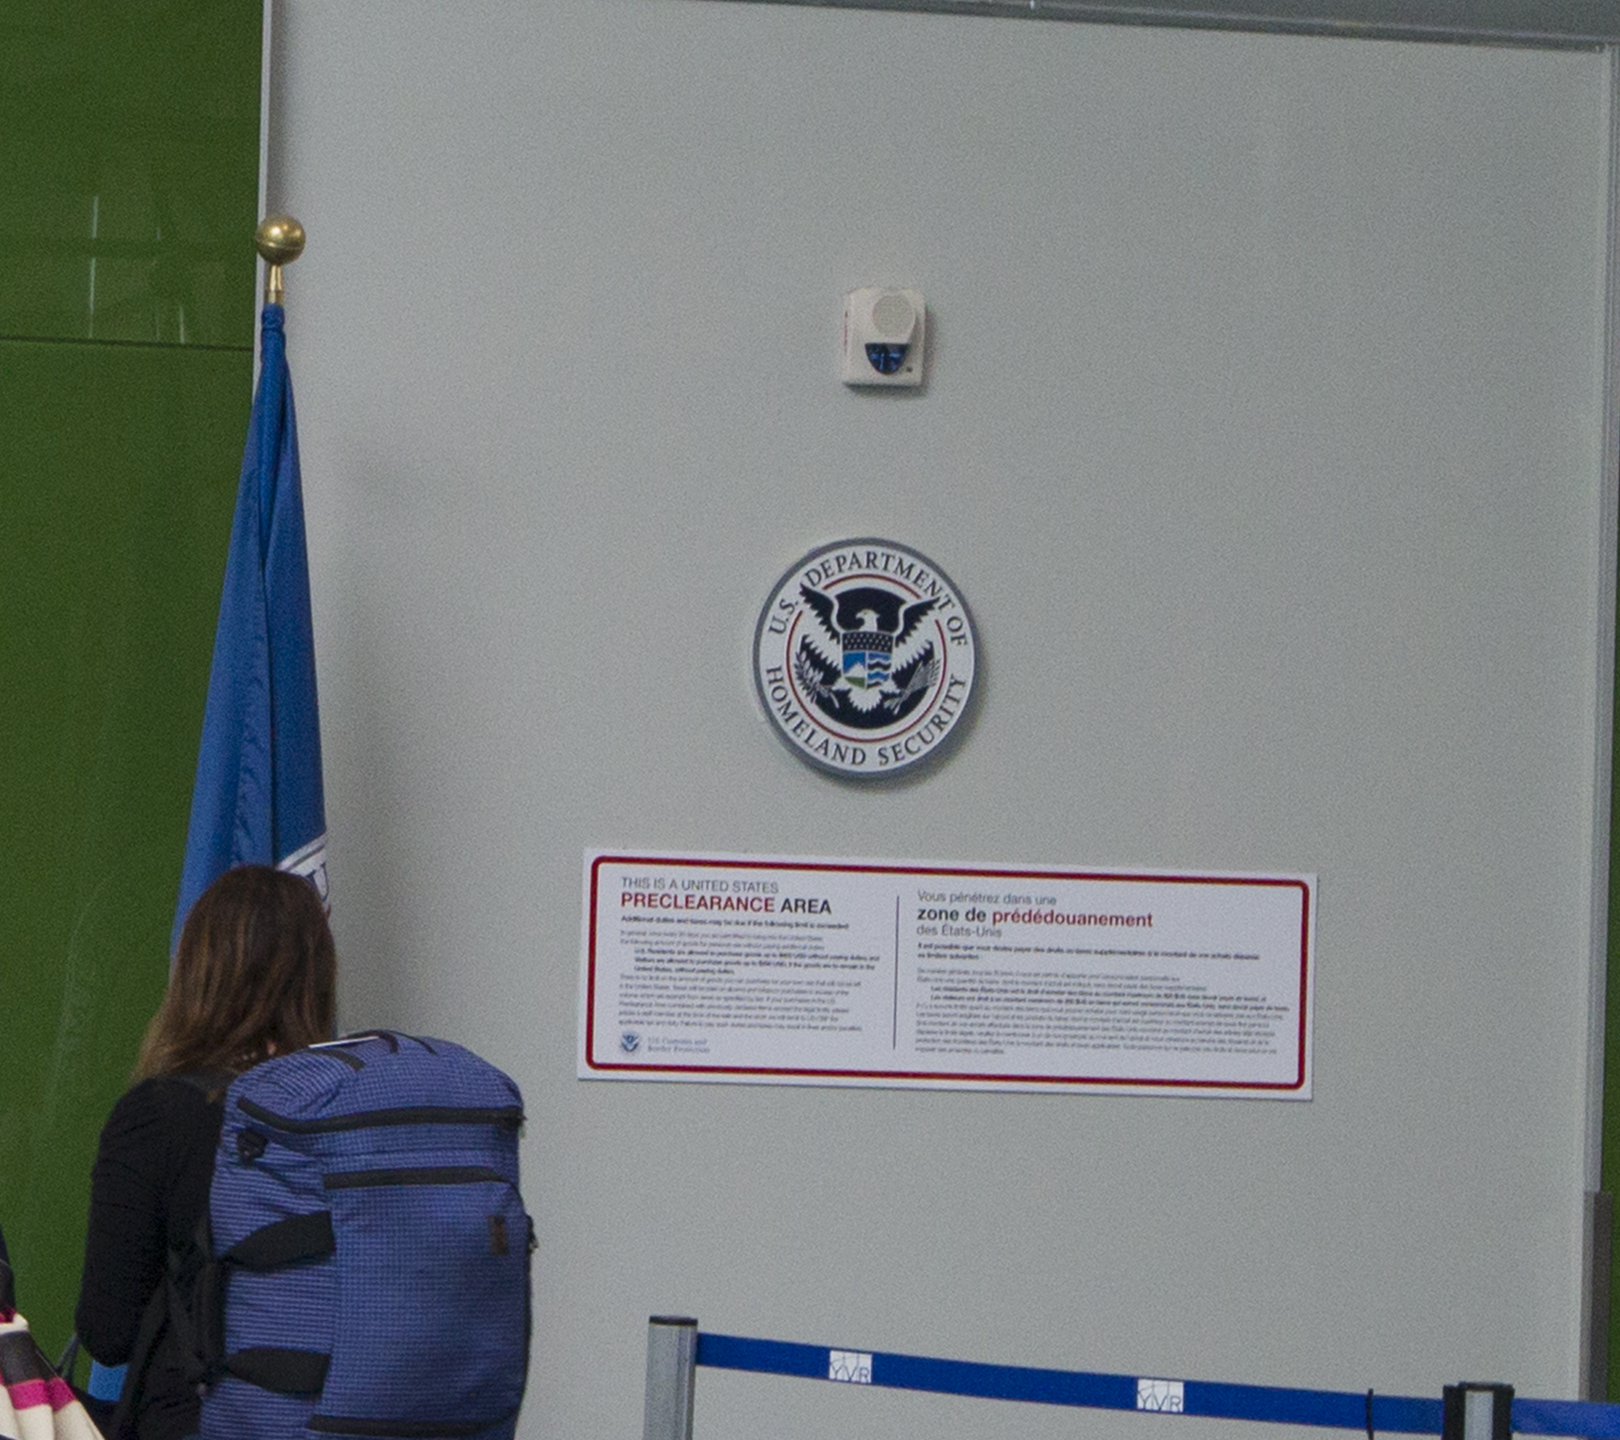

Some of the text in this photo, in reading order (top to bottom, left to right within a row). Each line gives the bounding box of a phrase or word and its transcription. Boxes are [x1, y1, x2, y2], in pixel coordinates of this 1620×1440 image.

[768, 550, 968, 647] U.S. DEPARTMENT OF
[765, 665, 967, 767] HOMELAND SECURITY
[621, 876, 779, 894] THIS IS A UNITED STATES
[620, 892, 833, 915] PRECLEARANCE AREA
[918, 890, 1057, 906] Vous pénétrez dans une
[917, 907, 1153, 928] zone de prédédouanement
[917, 923, 1002, 938] des États-Unis
[830, 1361, 871, 1382] YVR
[1137, 1390, 1183, 1413] YVR
